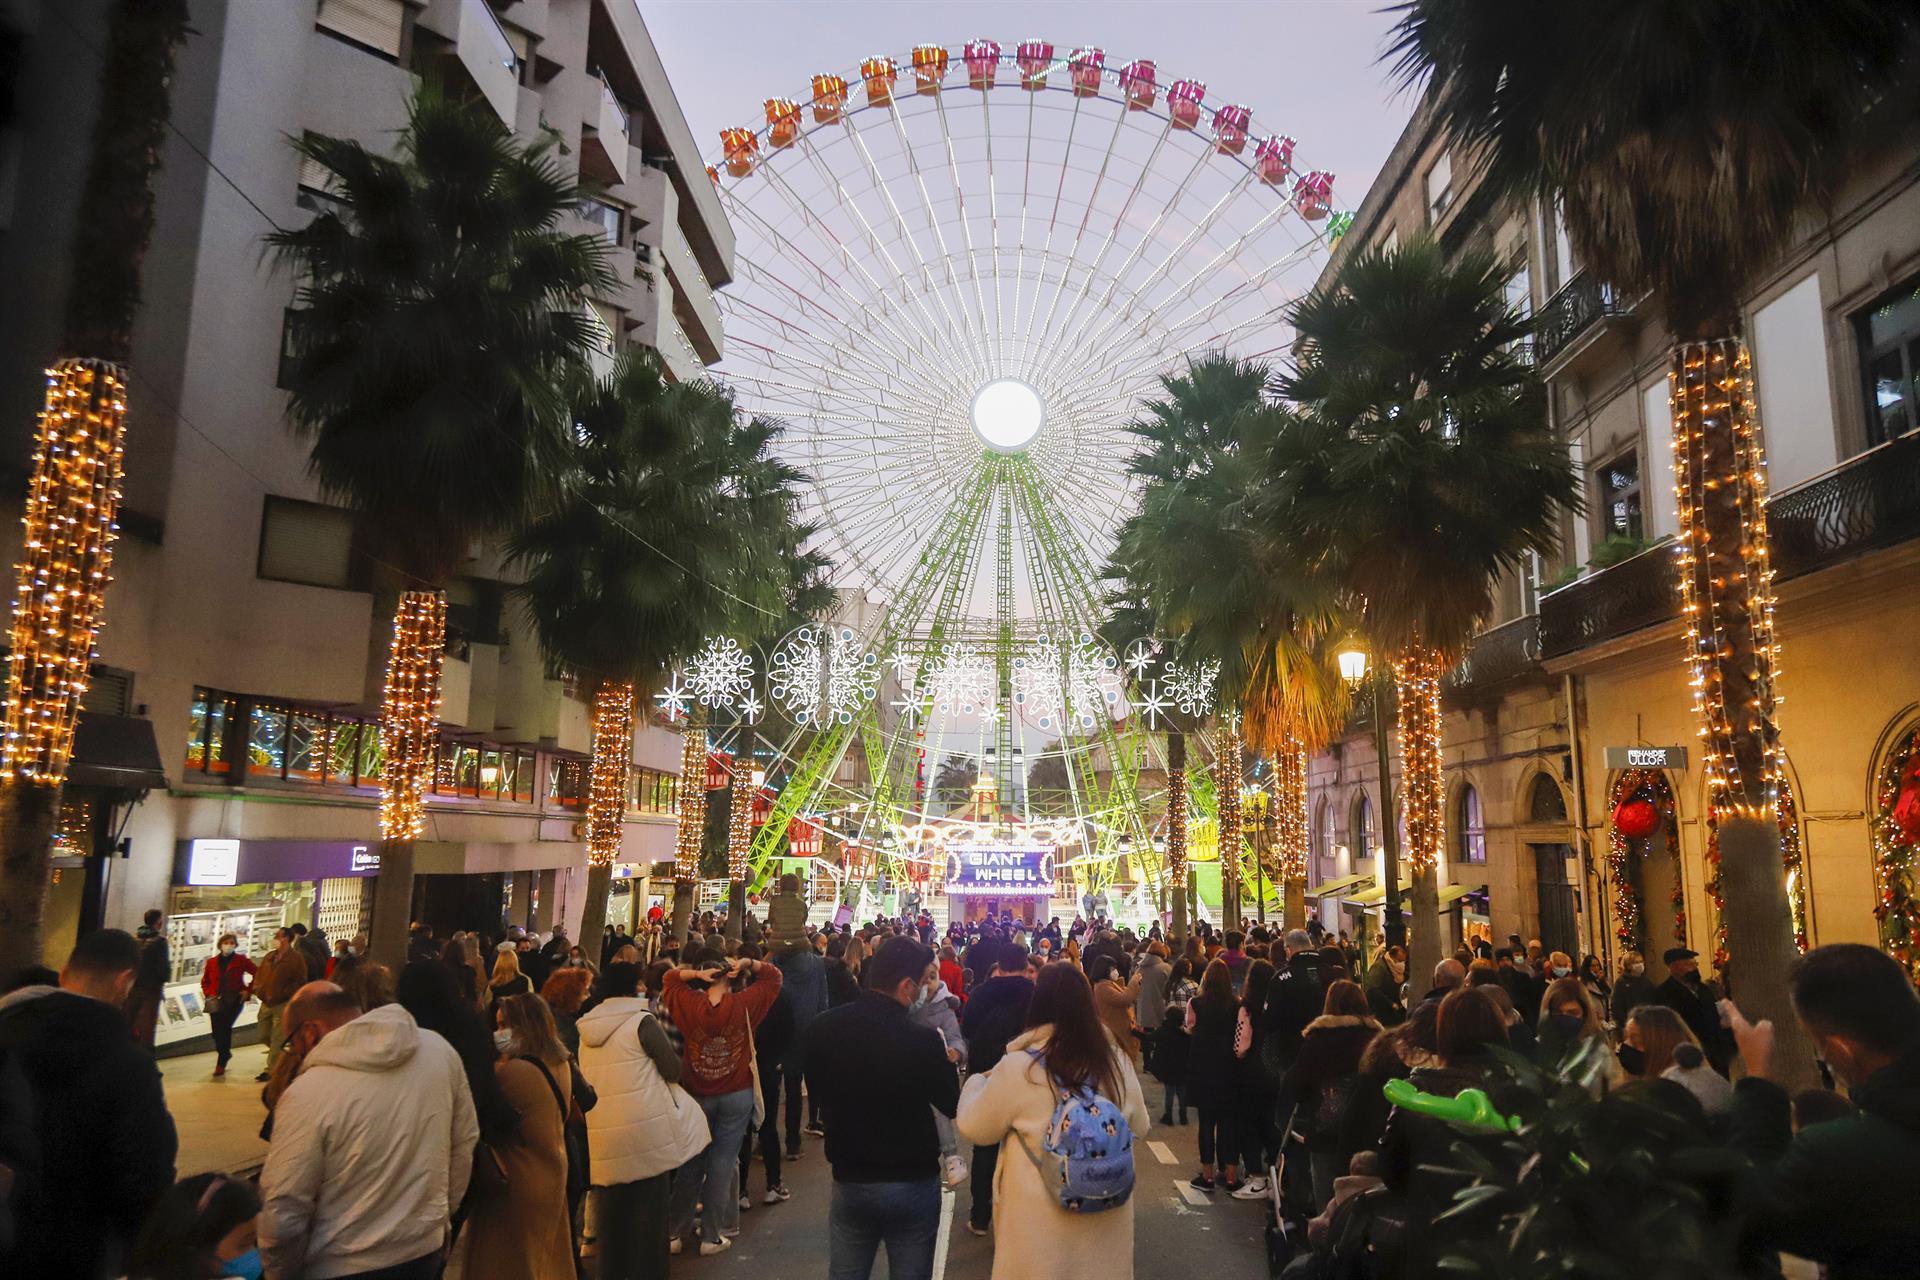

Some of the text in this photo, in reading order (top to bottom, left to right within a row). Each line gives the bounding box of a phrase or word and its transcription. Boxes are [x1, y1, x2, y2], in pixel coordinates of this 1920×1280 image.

[969, 852, 1025, 866] GIANT
[975, 868, 1037, 881] WHEEL
[1138, 926, 1146, 938] 6
